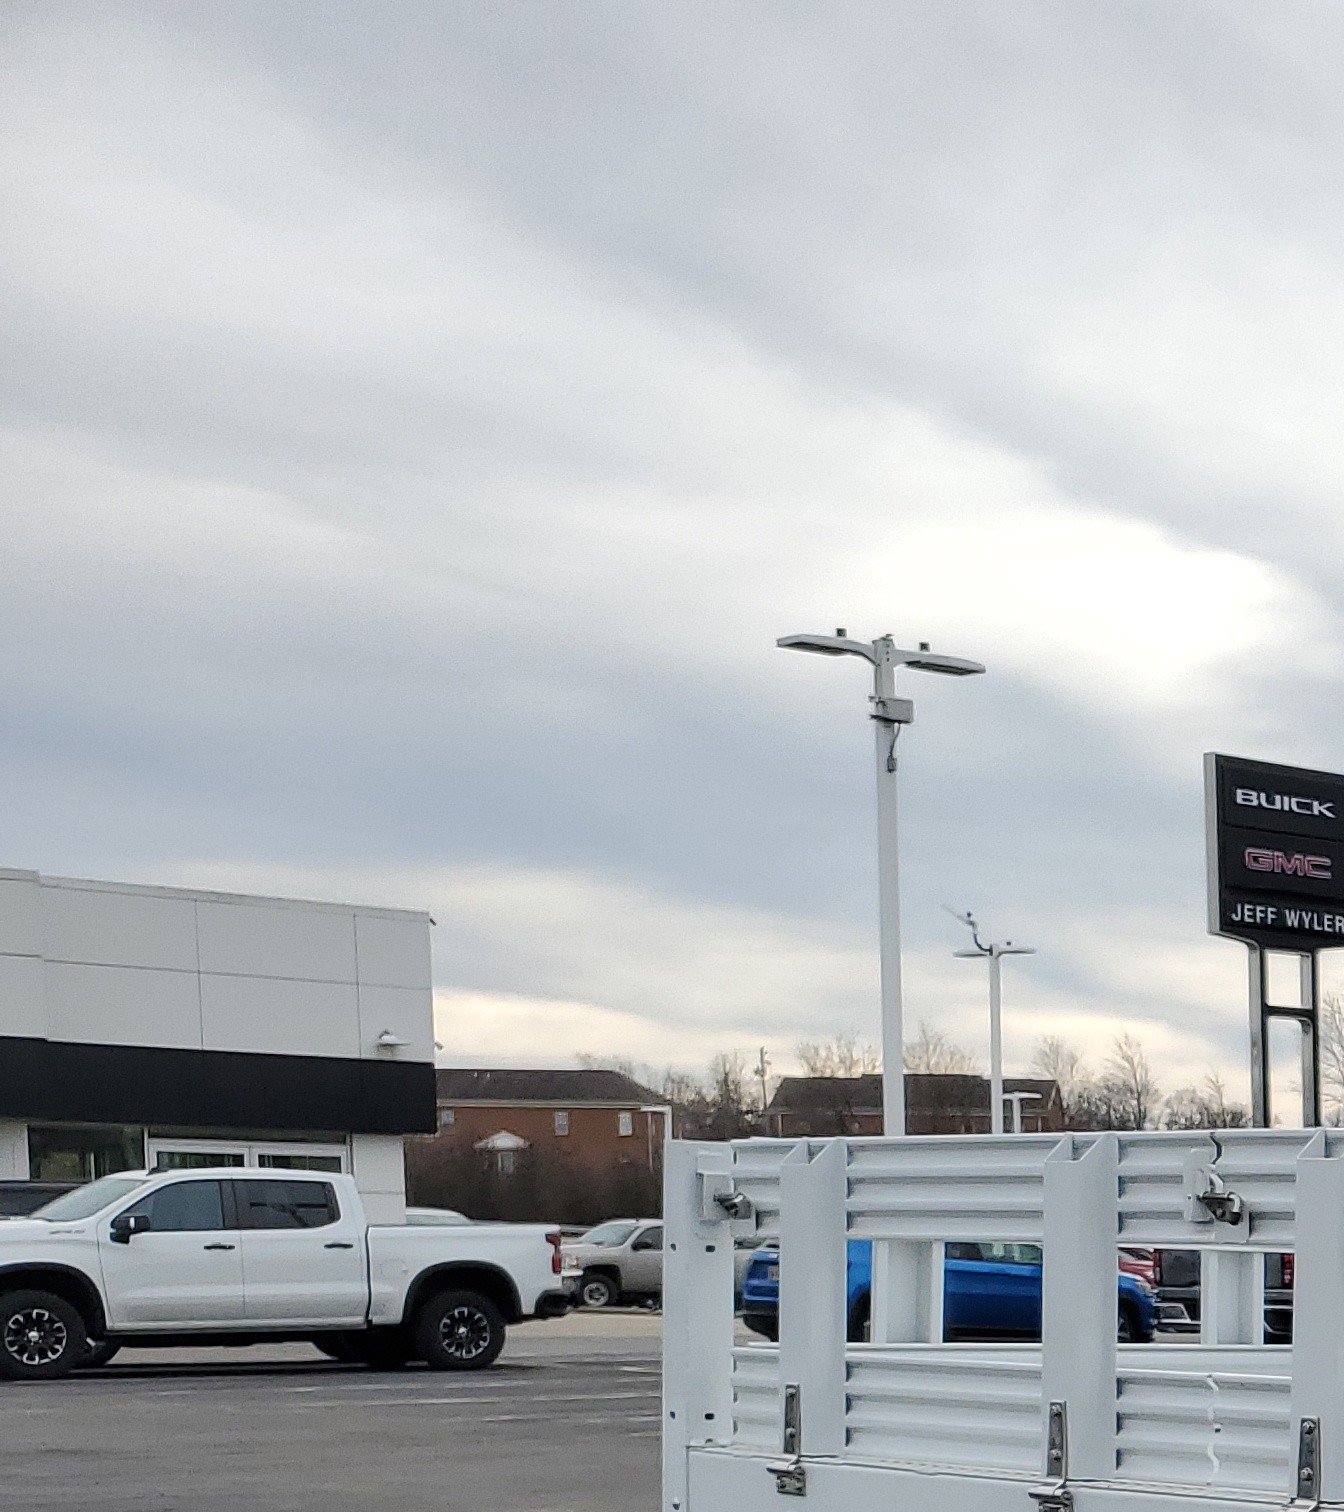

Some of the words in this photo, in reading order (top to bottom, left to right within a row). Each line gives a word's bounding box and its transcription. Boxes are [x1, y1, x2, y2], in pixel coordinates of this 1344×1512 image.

[1236, 788, 1336, 818] BUICK
[1244, 847, 1332, 879] GMC
[1231, 902, 1277, 925] JEFF
